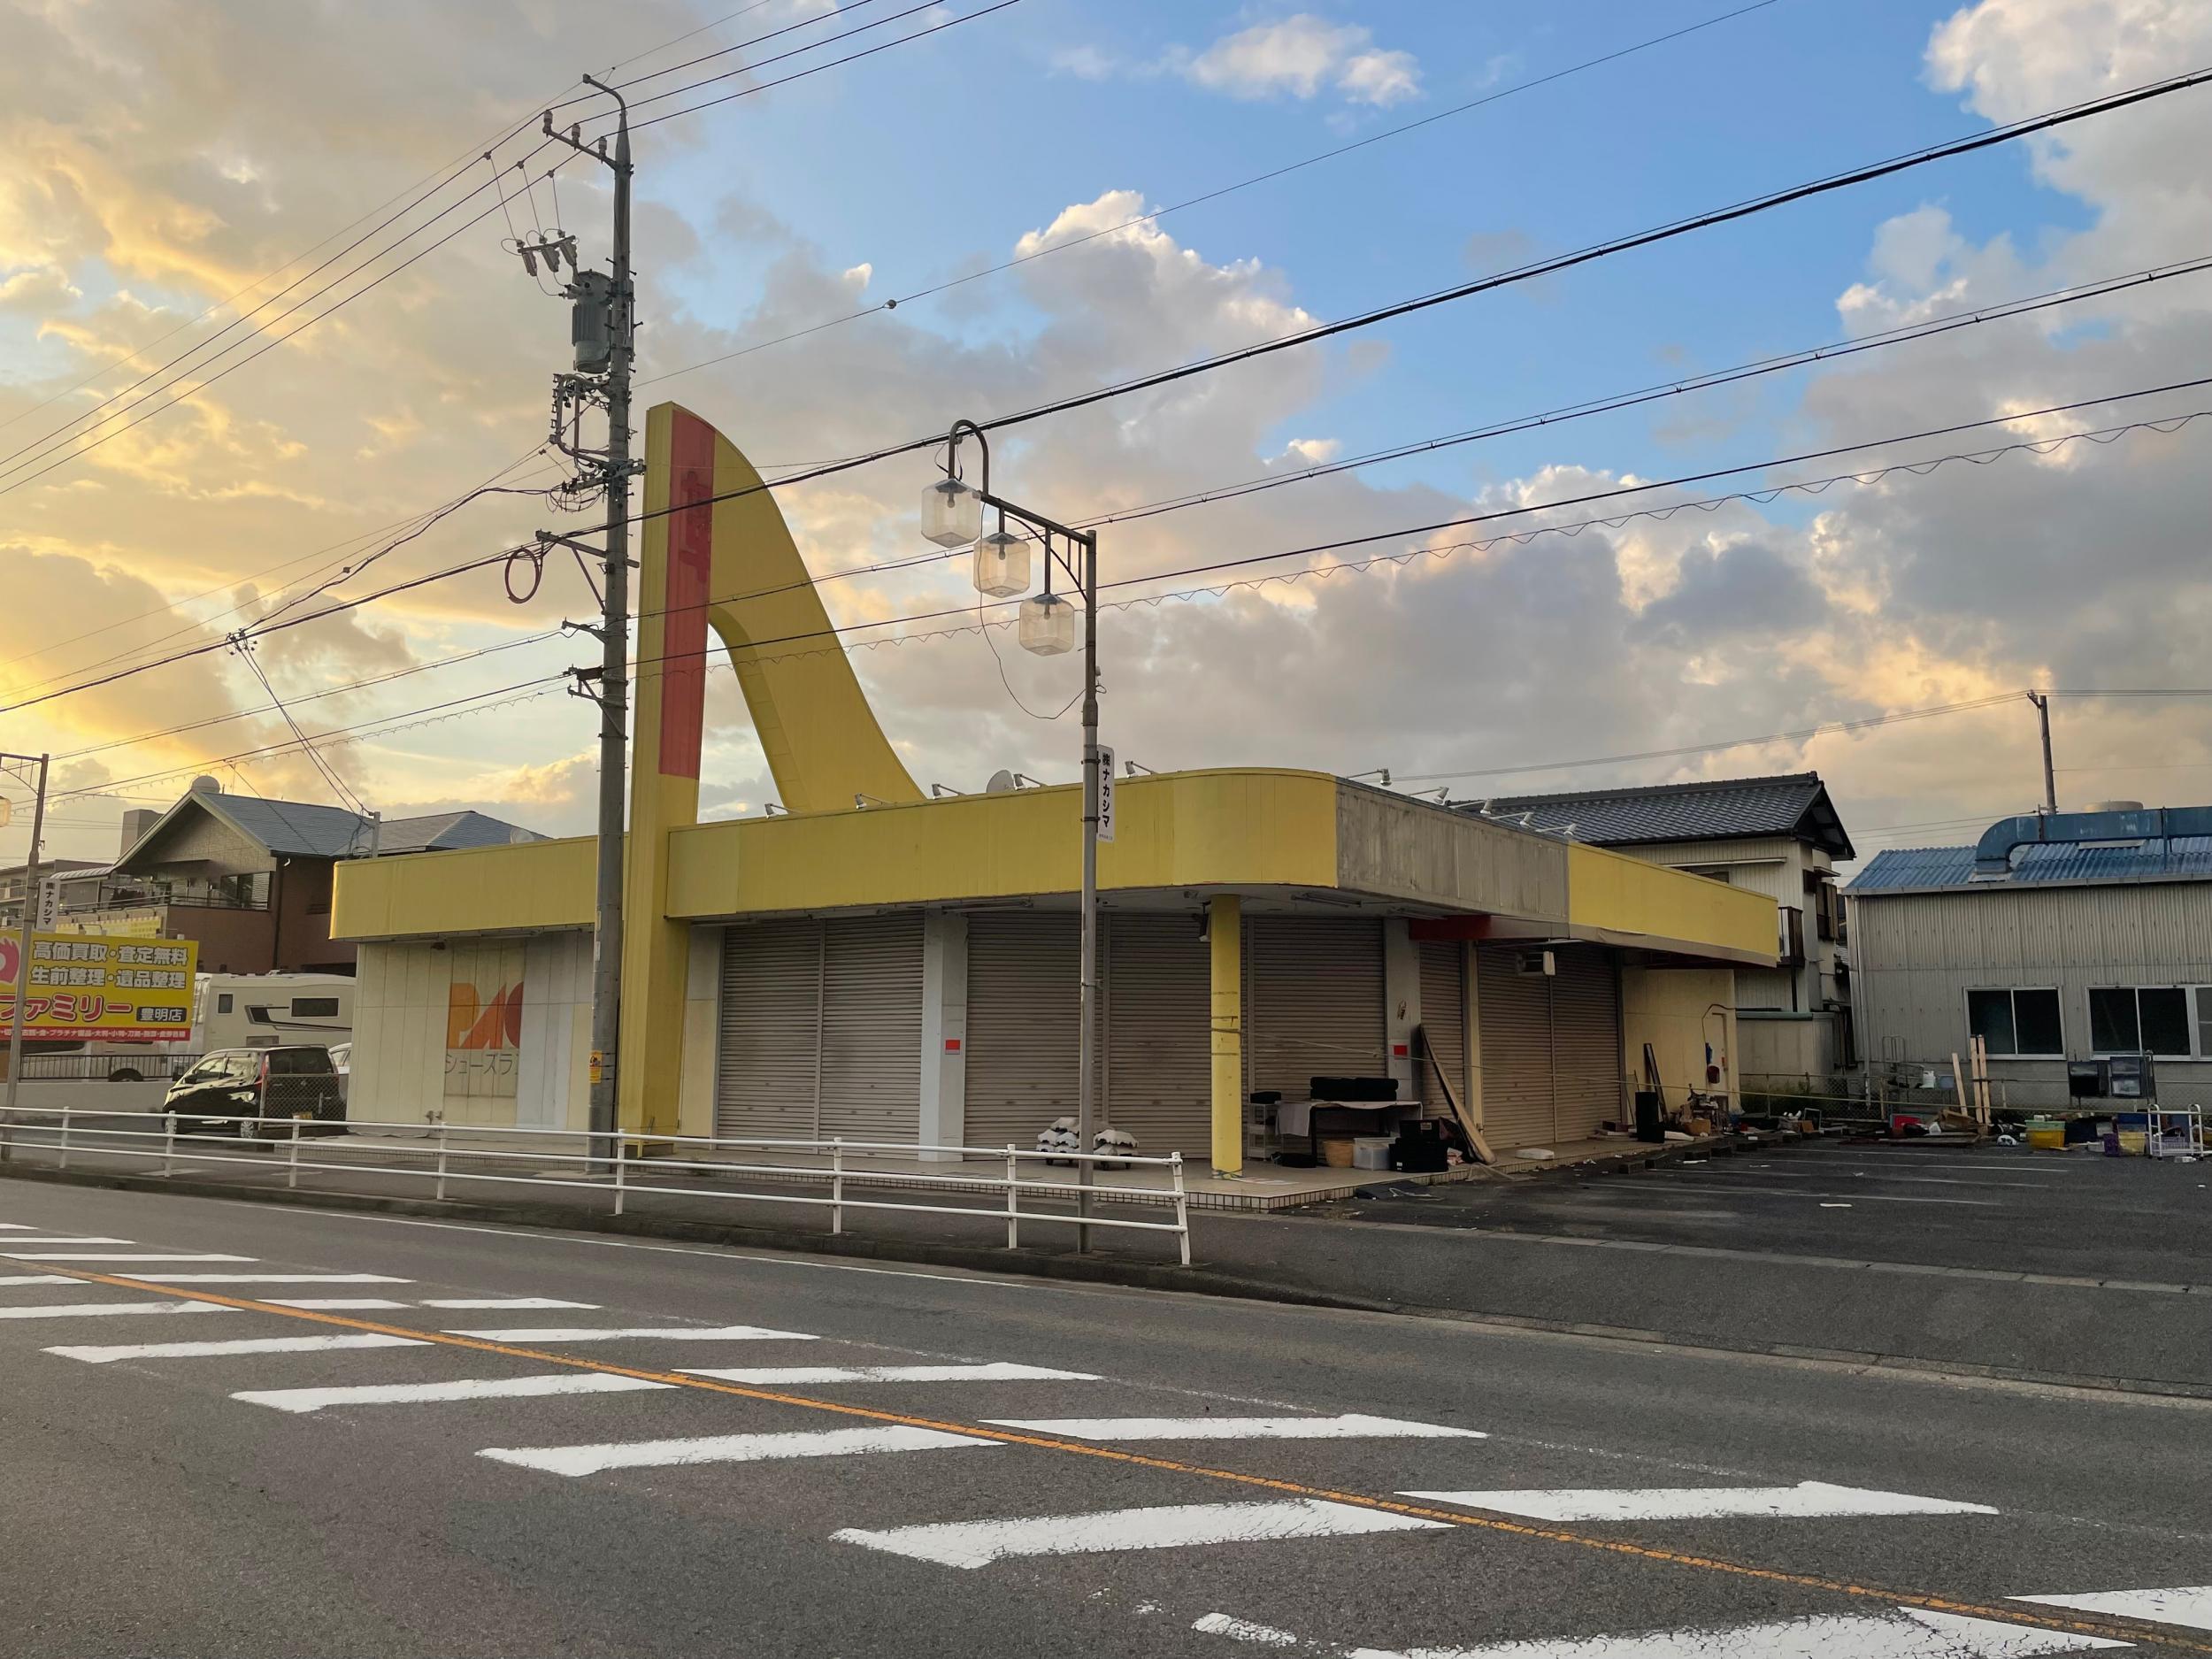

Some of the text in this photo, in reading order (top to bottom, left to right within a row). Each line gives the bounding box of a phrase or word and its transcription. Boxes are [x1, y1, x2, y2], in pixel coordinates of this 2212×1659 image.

[33, 941, 188, 966] 高価買取・査定無料
[30, 965, 186, 989] 生前整理・遺品整理
[444, 1053, 519, 1075] シューズラ
